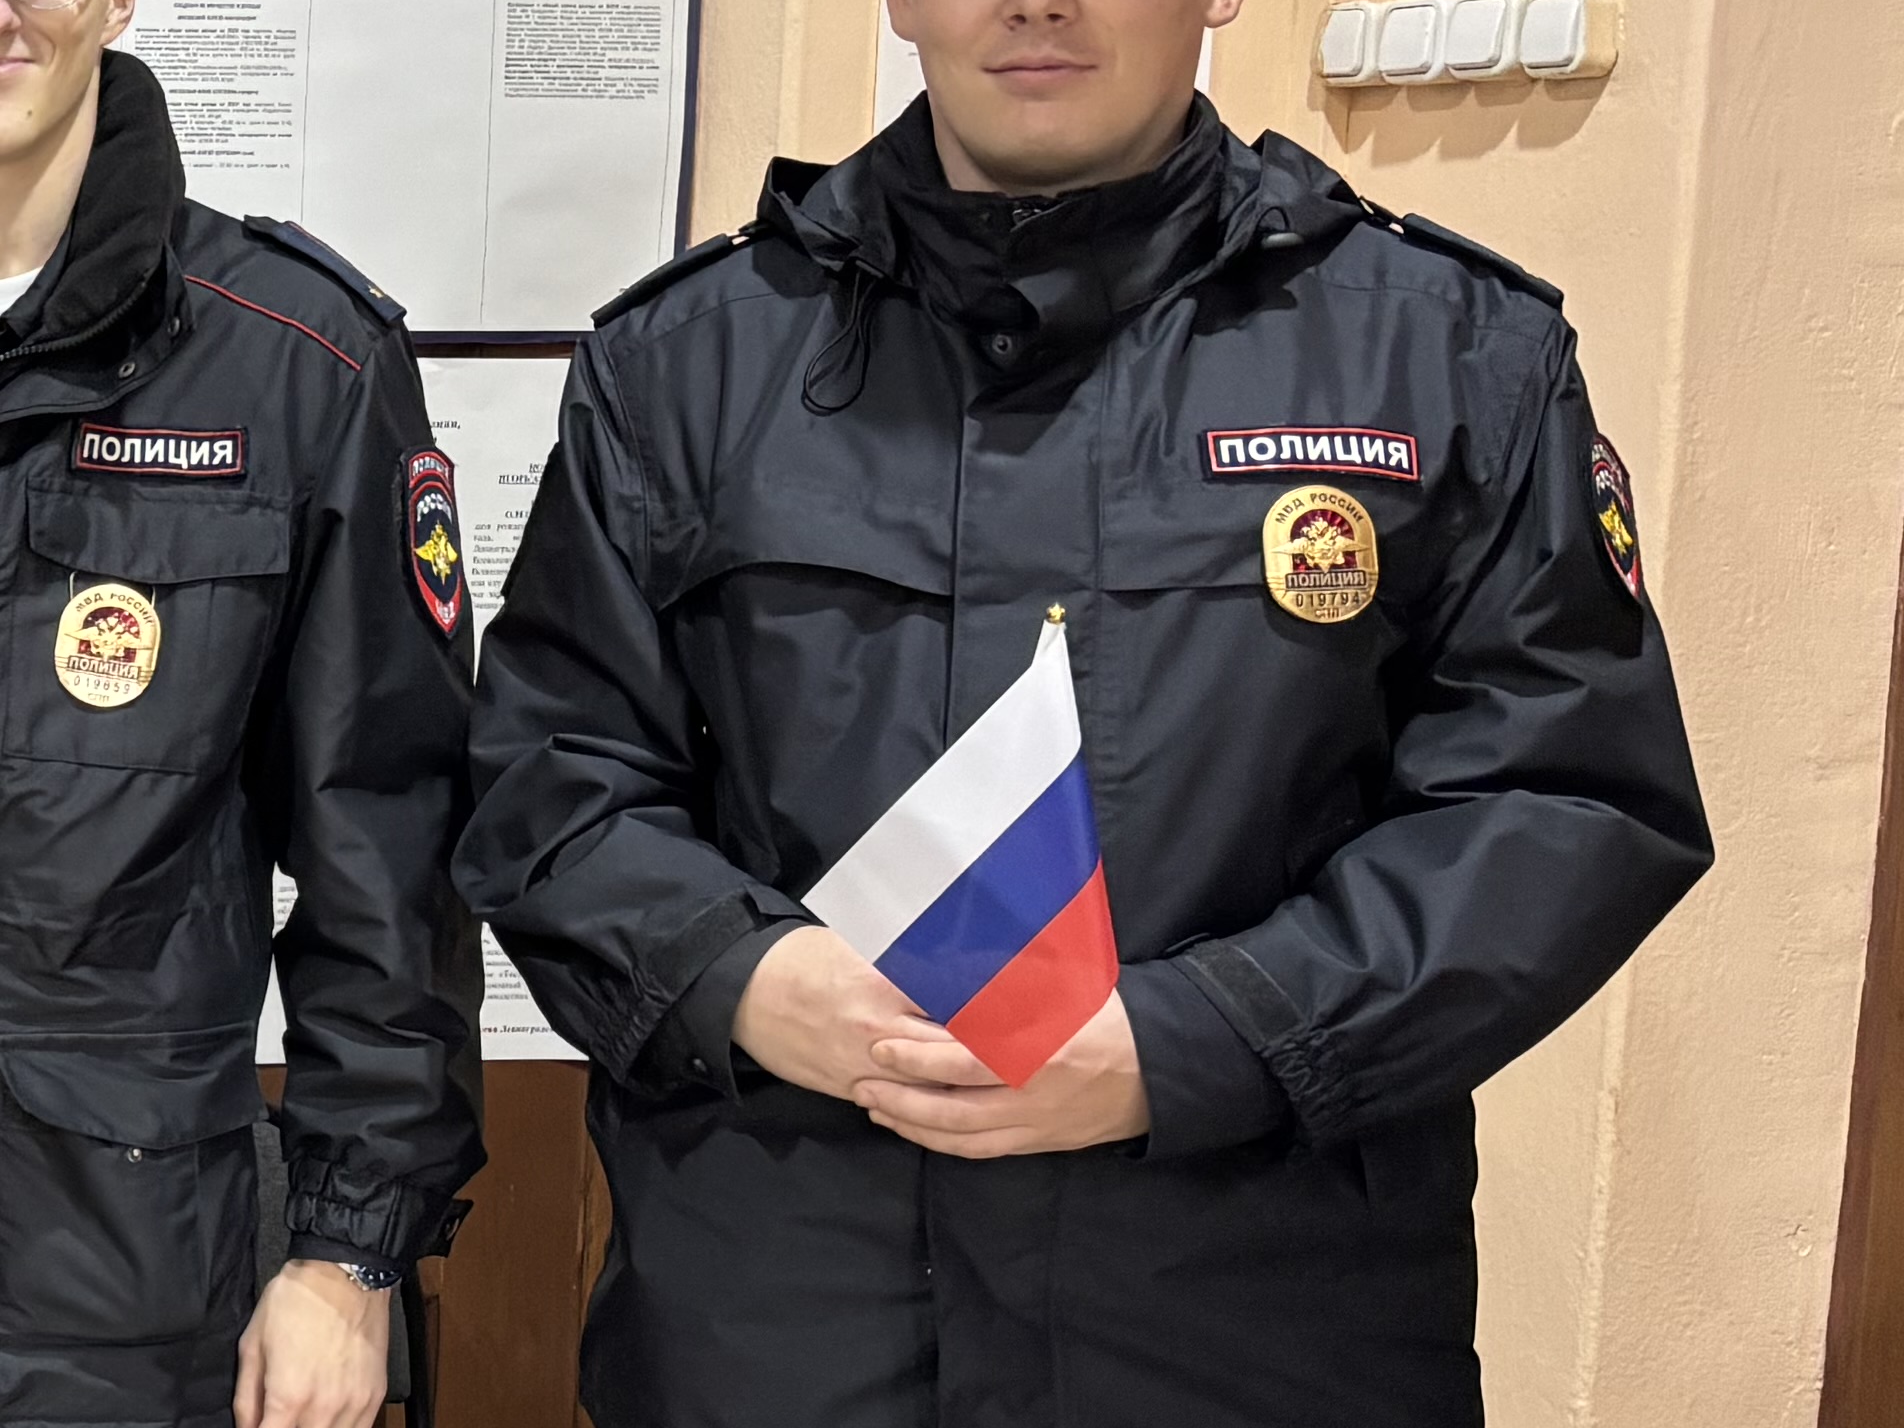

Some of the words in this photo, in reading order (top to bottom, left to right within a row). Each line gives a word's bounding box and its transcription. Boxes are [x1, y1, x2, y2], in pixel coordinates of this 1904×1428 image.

[82, 432, 234, 470] ПОЛИЦИЯ
[1219, 434, 1410, 470] ПОЛИЦИЯ
[1275, 497, 1306, 524] МВД
[1309, 492, 1364, 523] РОССИИ
[1287, 572, 1365, 588] ПОЛИЦИЯ
[68, 656, 139, 680] ПОЛИЦИЯ
